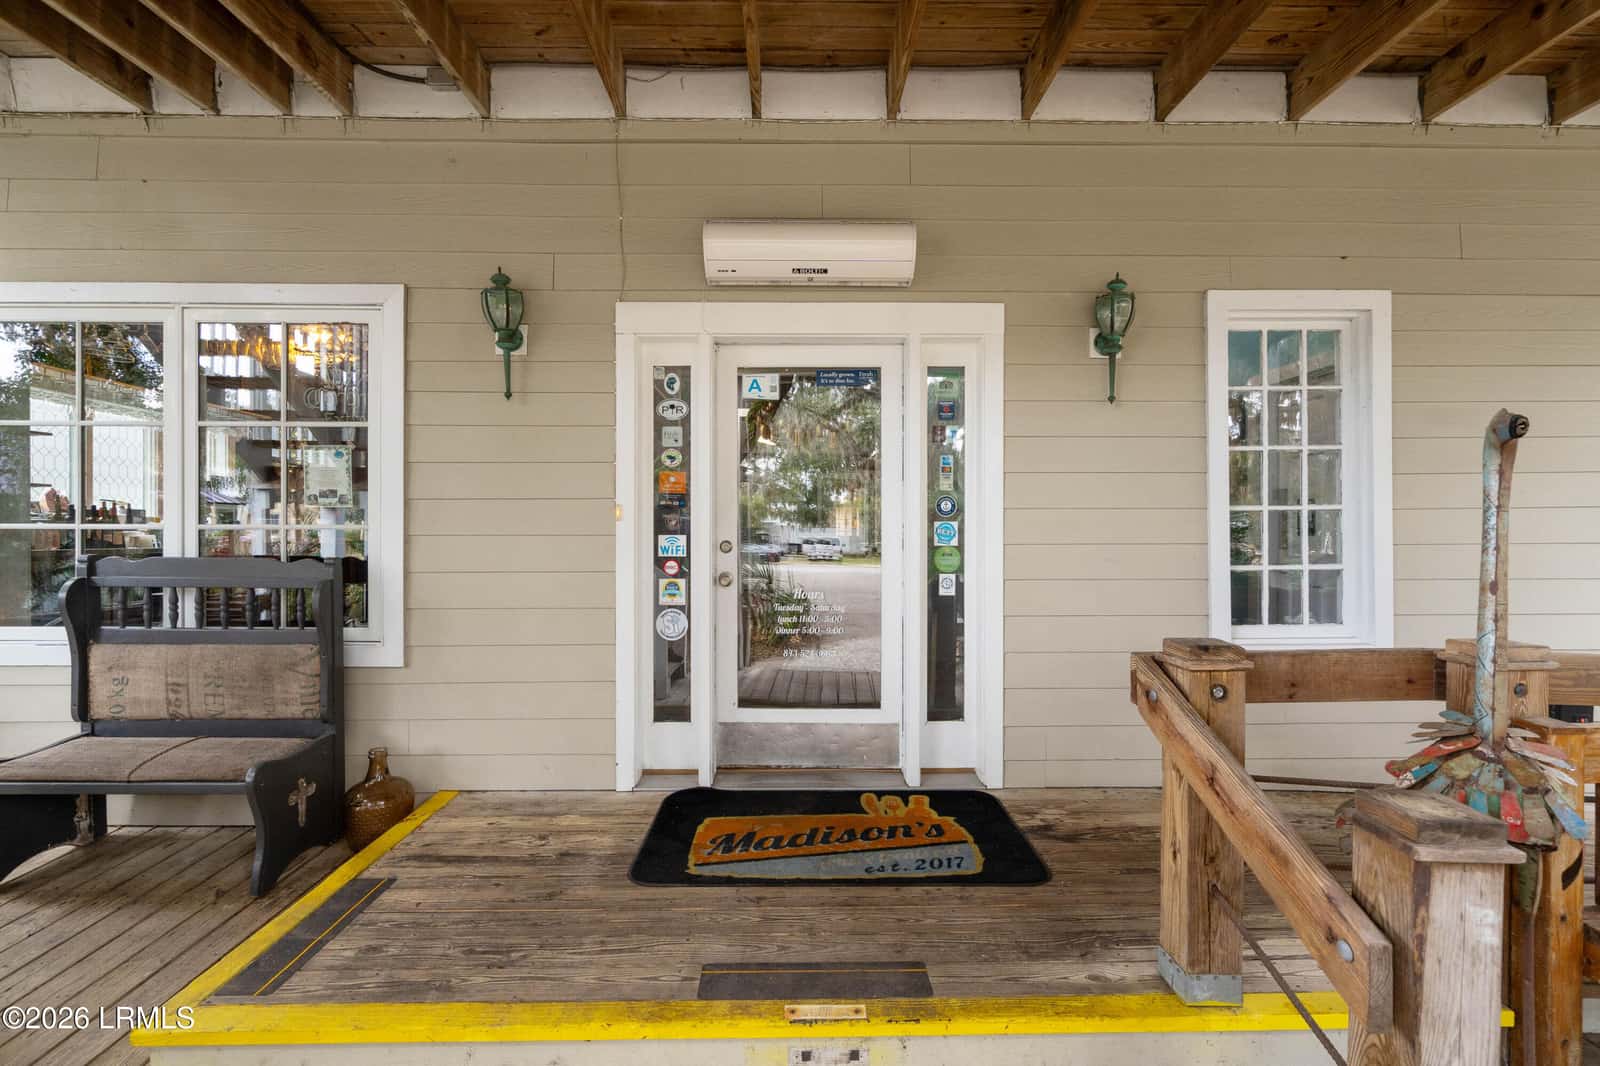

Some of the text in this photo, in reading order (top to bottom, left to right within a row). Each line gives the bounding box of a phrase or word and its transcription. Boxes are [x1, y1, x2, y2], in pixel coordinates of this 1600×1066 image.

[748, 378, 762, 393] A
[660, 544, 685, 556] WiFi
[794, 588, 824, 599] Hours
[773, 603, 805, 613] Tuesday
[775, 626, 801, 634] Dinner
[706, 821, 945, 856] Madison's
[864, 856, 908, 875] est.
[914, 856, 965, 872] 2017
